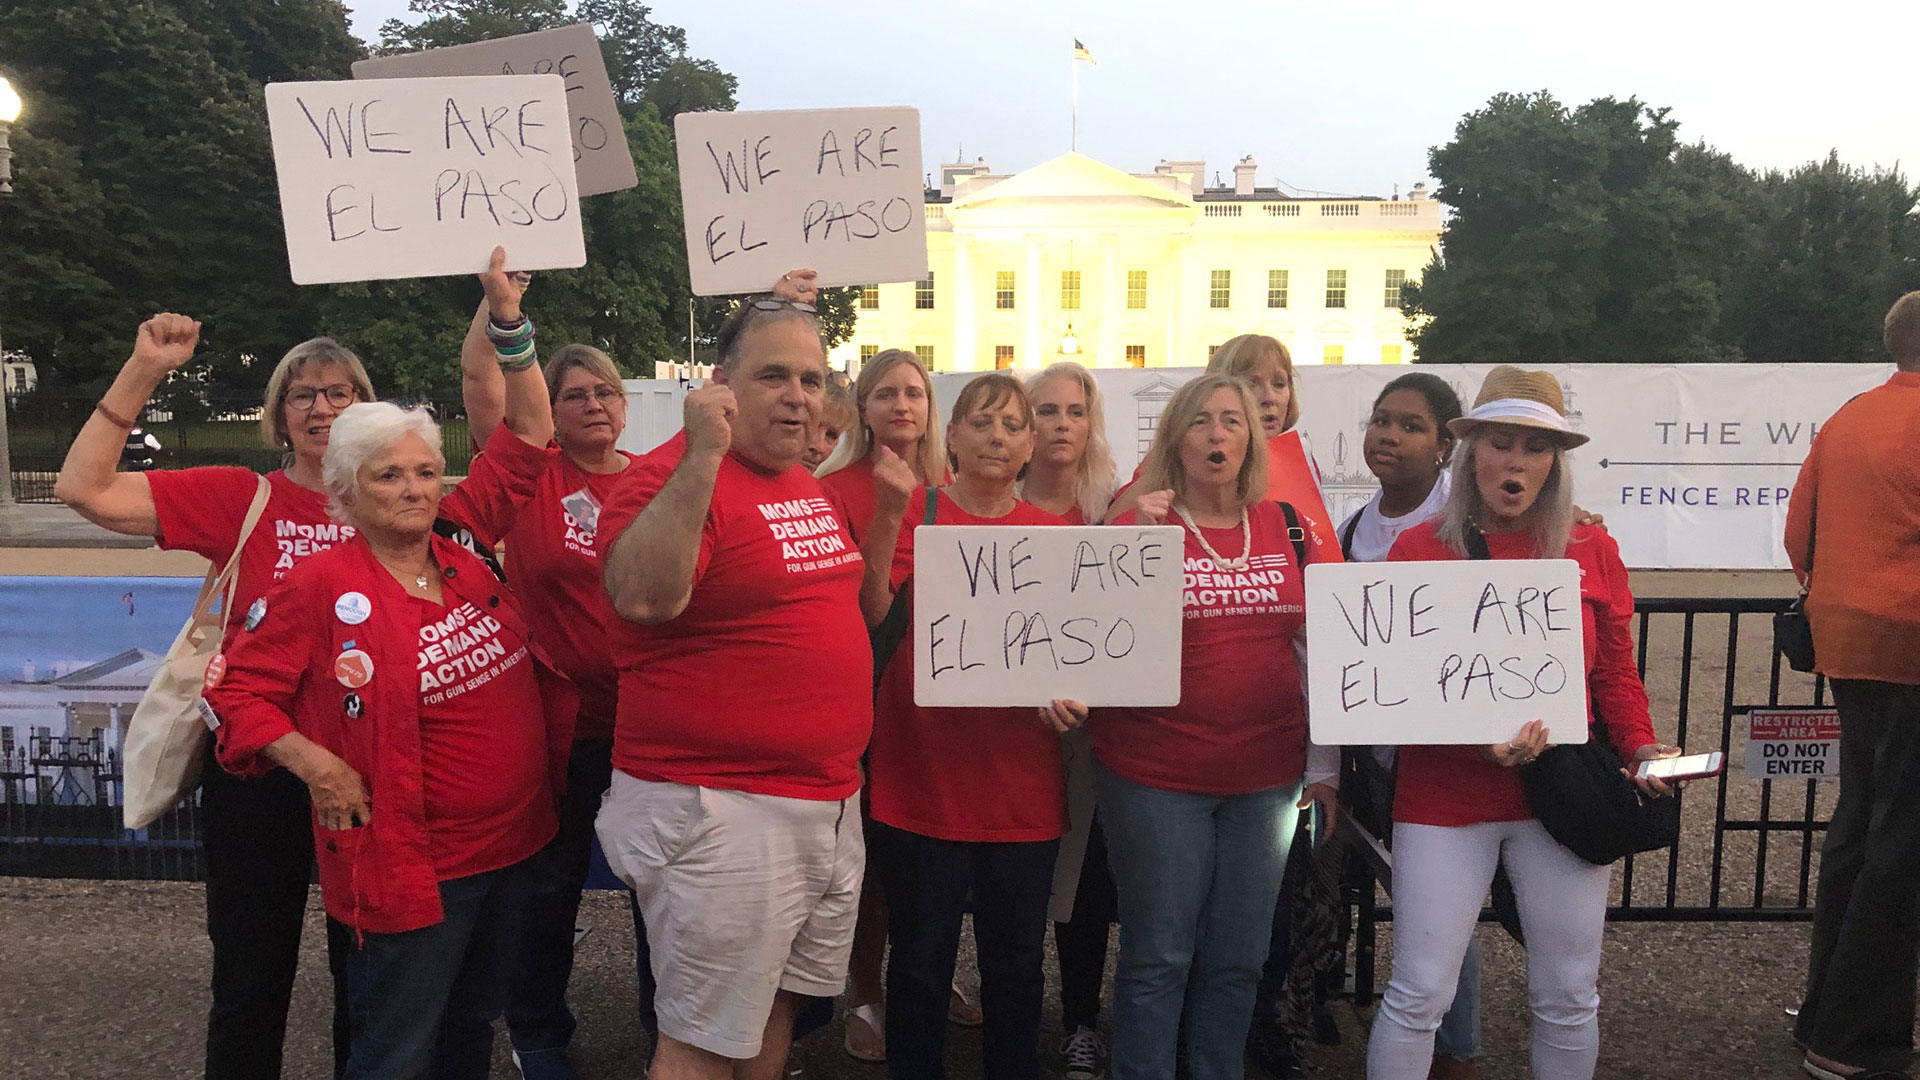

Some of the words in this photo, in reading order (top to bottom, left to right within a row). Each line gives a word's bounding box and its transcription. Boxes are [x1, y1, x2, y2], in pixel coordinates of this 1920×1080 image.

[296, 96, 411, 158] WE
[446, 97, 551, 158] ARE
[706, 135, 781, 194] WE
[817, 126, 900, 176] ARE
[326, 184, 402, 241] EL
[435, 164, 567, 226] PASO
[706, 215, 768, 265] EL
[803, 197, 912, 243] PASO
[1655, 422, 1741, 445] THE
[1621, 486, 1719, 506] FENCE
[757, 499, 813, 520] MOMS
[275, 520, 356, 543] MOMS
[769, 515, 839, 540] DEMAND
[782, 534, 846, 559] ACTION
[786, 563, 802, 573] FOR
[958, 537, 1042, 597] WE
[1071, 535, 1162, 593] ARE
[1183, 570, 1285, 588] DEMAND
[1183, 587, 1280, 607] ACTION
[1203, 608, 1222, 618] GUN
[1225, 606, 1254, 616] SENSE
[1255, 605, 1265, 614] IN
[1332, 579, 1440, 646] WE
[1473, 582, 1571, 640] ARE
[419, 608, 466, 646] OMS
[931, 614, 985, 680] EL
[1004, 610, 1135, 671] PASO
[421, 638, 505, 692] ACTION
[423, 692, 444, 706] FOR
[445, 684, 466, 699] GUN
[466, 671, 492, 690] SENSE
[489, 666, 500, 678] IN
[1341, 660, 1409, 713] EL
[1437, 653, 1567, 703] PASO
[1753, 715, 1841, 727] RESTRICTED
[1779, 727, 1817, 738] AREA
[1763, 743, 1789, 757] DO
[1795, 743, 1831, 757] NOT
[1766, 760, 1825, 774] ENTER
